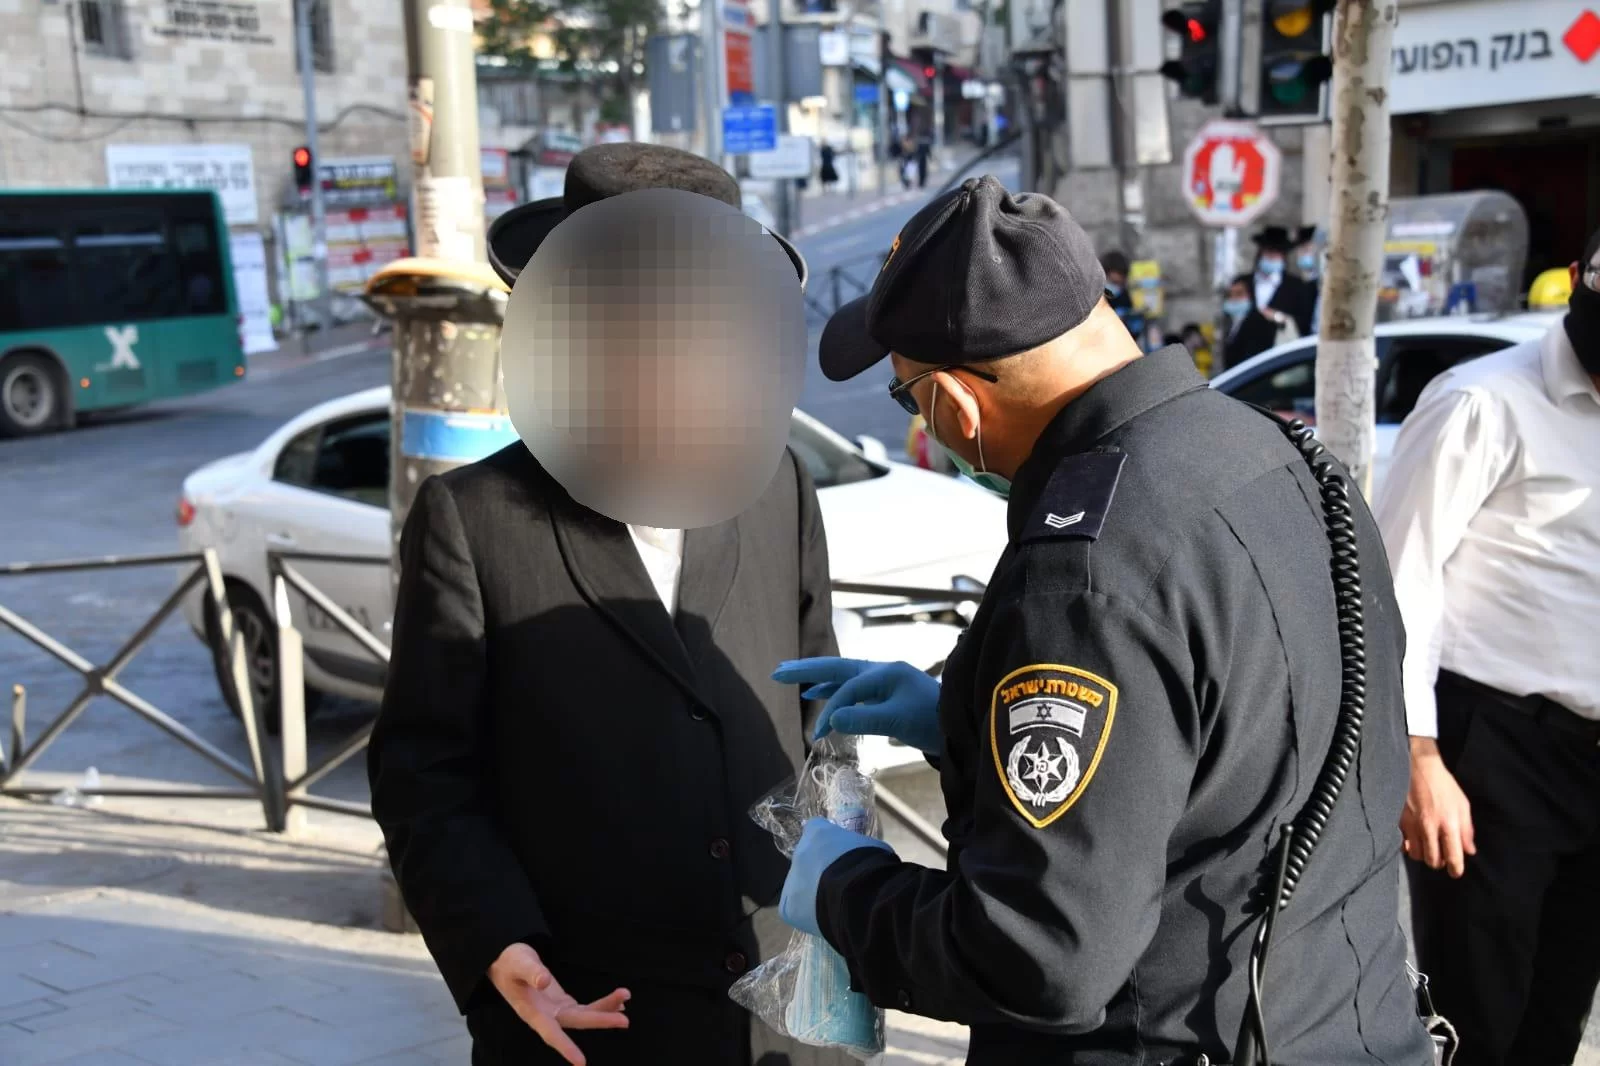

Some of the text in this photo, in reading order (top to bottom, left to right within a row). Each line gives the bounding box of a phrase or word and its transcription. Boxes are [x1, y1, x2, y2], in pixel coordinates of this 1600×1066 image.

[1391, 30, 1553, 73] בנק הפוע
[1001, 679, 1104, 707] משטרת ישראל
